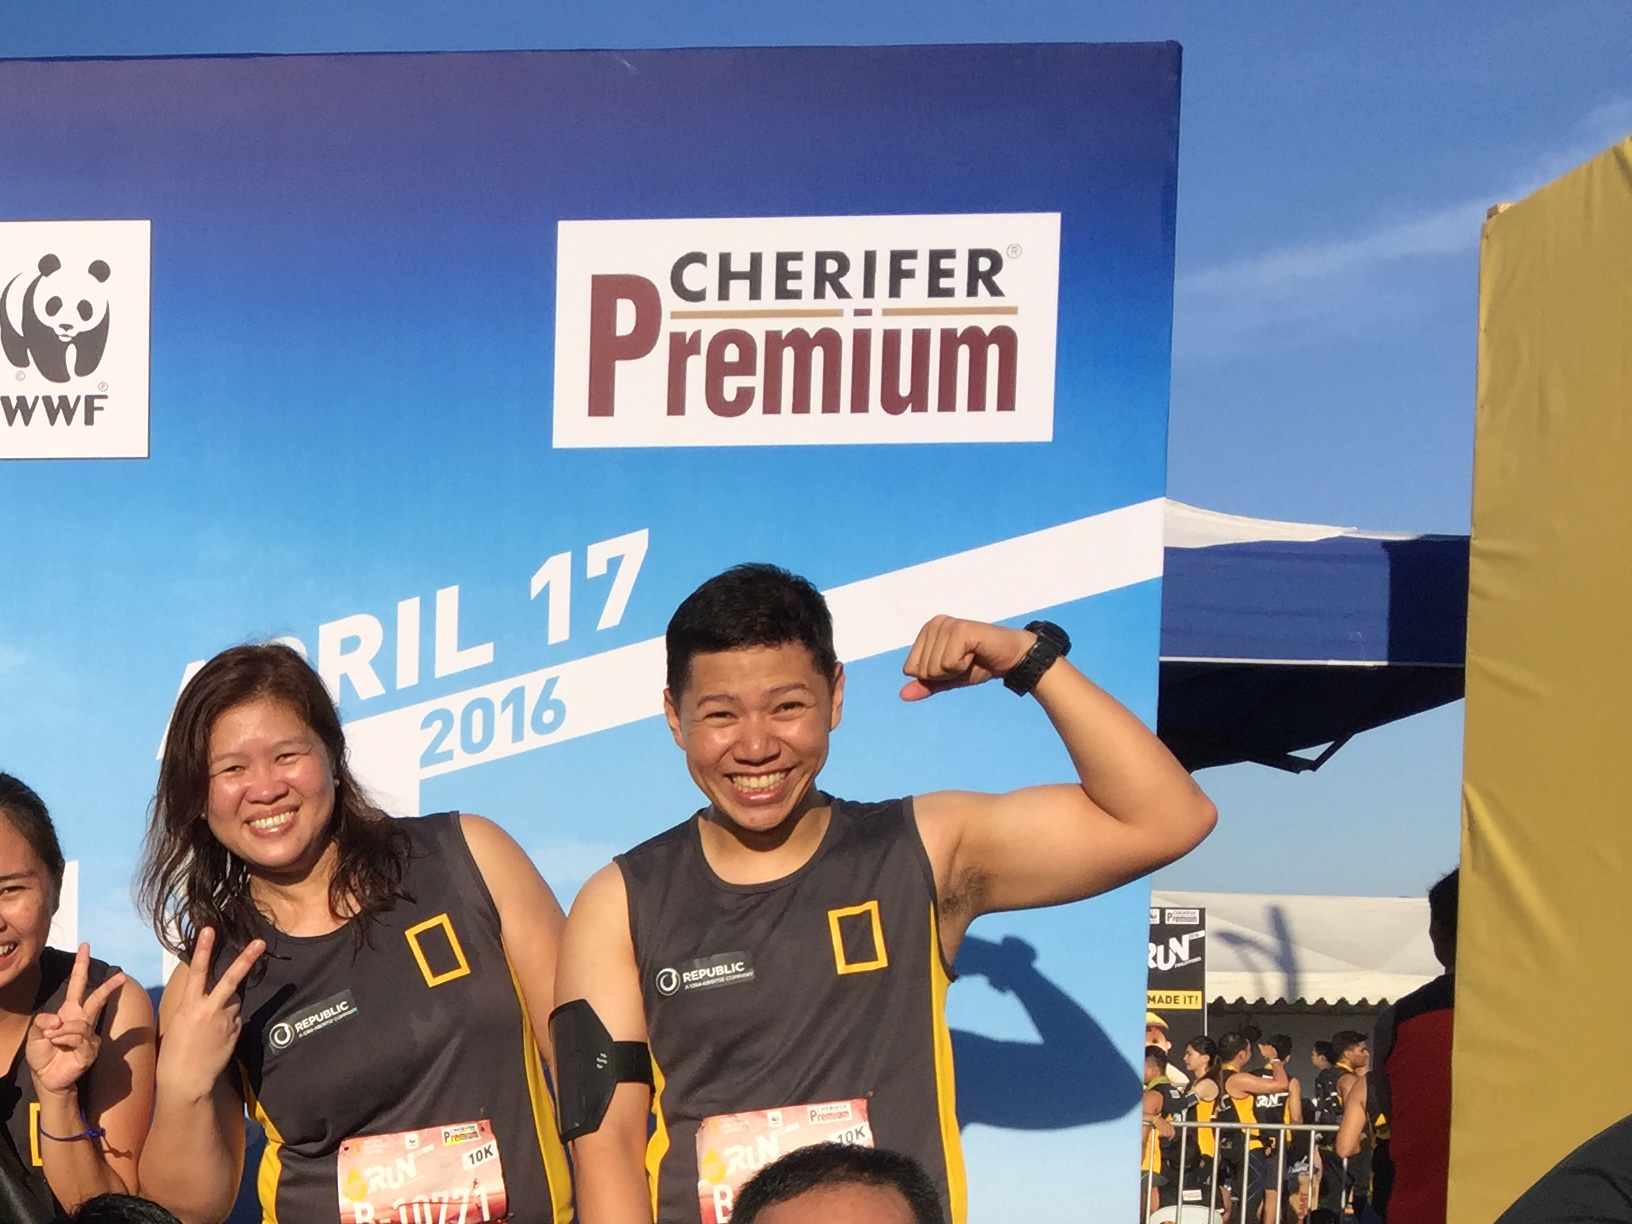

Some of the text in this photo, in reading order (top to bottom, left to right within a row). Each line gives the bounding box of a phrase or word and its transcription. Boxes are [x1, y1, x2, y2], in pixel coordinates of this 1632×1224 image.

[670, 248, 1006, 302] CHERIFER
[587, 274, 1019, 418] Premium
[0, 395, 109, 427] WWF
[530, 528, 650, 645] 17
[419, 675, 567, 769] 2016
[682, 962, 745, 983] REPUBLIC
[294, 1001, 349, 1033] REPUBLIC
[1147, 995, 1199, 1005] MADE IT!
[468, 1144, 494, 1165] 10K
[723, 1132, 779, 1176] RUN
[836, 1126, 866, 1147] 10K
[364, 1152, 417, 1195] RUN
